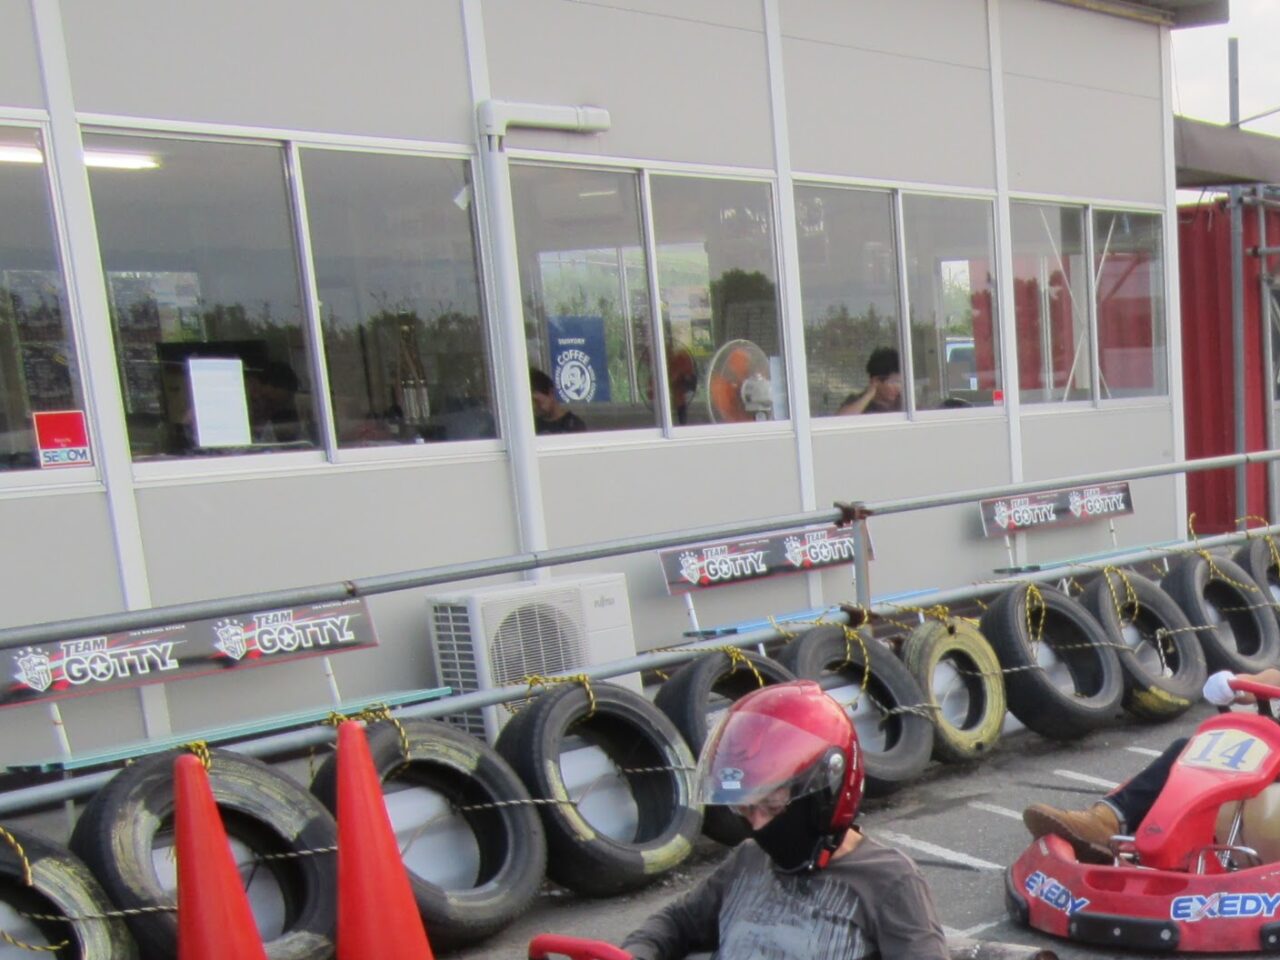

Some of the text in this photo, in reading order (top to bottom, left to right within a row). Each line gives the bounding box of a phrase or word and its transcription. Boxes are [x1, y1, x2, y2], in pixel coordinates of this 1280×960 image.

[557, 349, 591, 366] COFFEE
[43, 448, 88, 463] SECOM
[1085, 493, 1125, 514] GOTTY
[1011, 503, 1056, 526] GOTTY
[805, 530, 827, 543] TEAM
[703, 545, 728, 559] TEAM
[705, 551, 767, 580] GOTTY
[253, 609, 294, 627] TEAM
[256, 614, 355, 656] GOTTY
[61, 636, 108, 656] TEAM
[63, 641, 180, 685] GOTTY
[1190, 731, 1257, 770] 14
[1025, 870, 1091, 916] EXEDY
